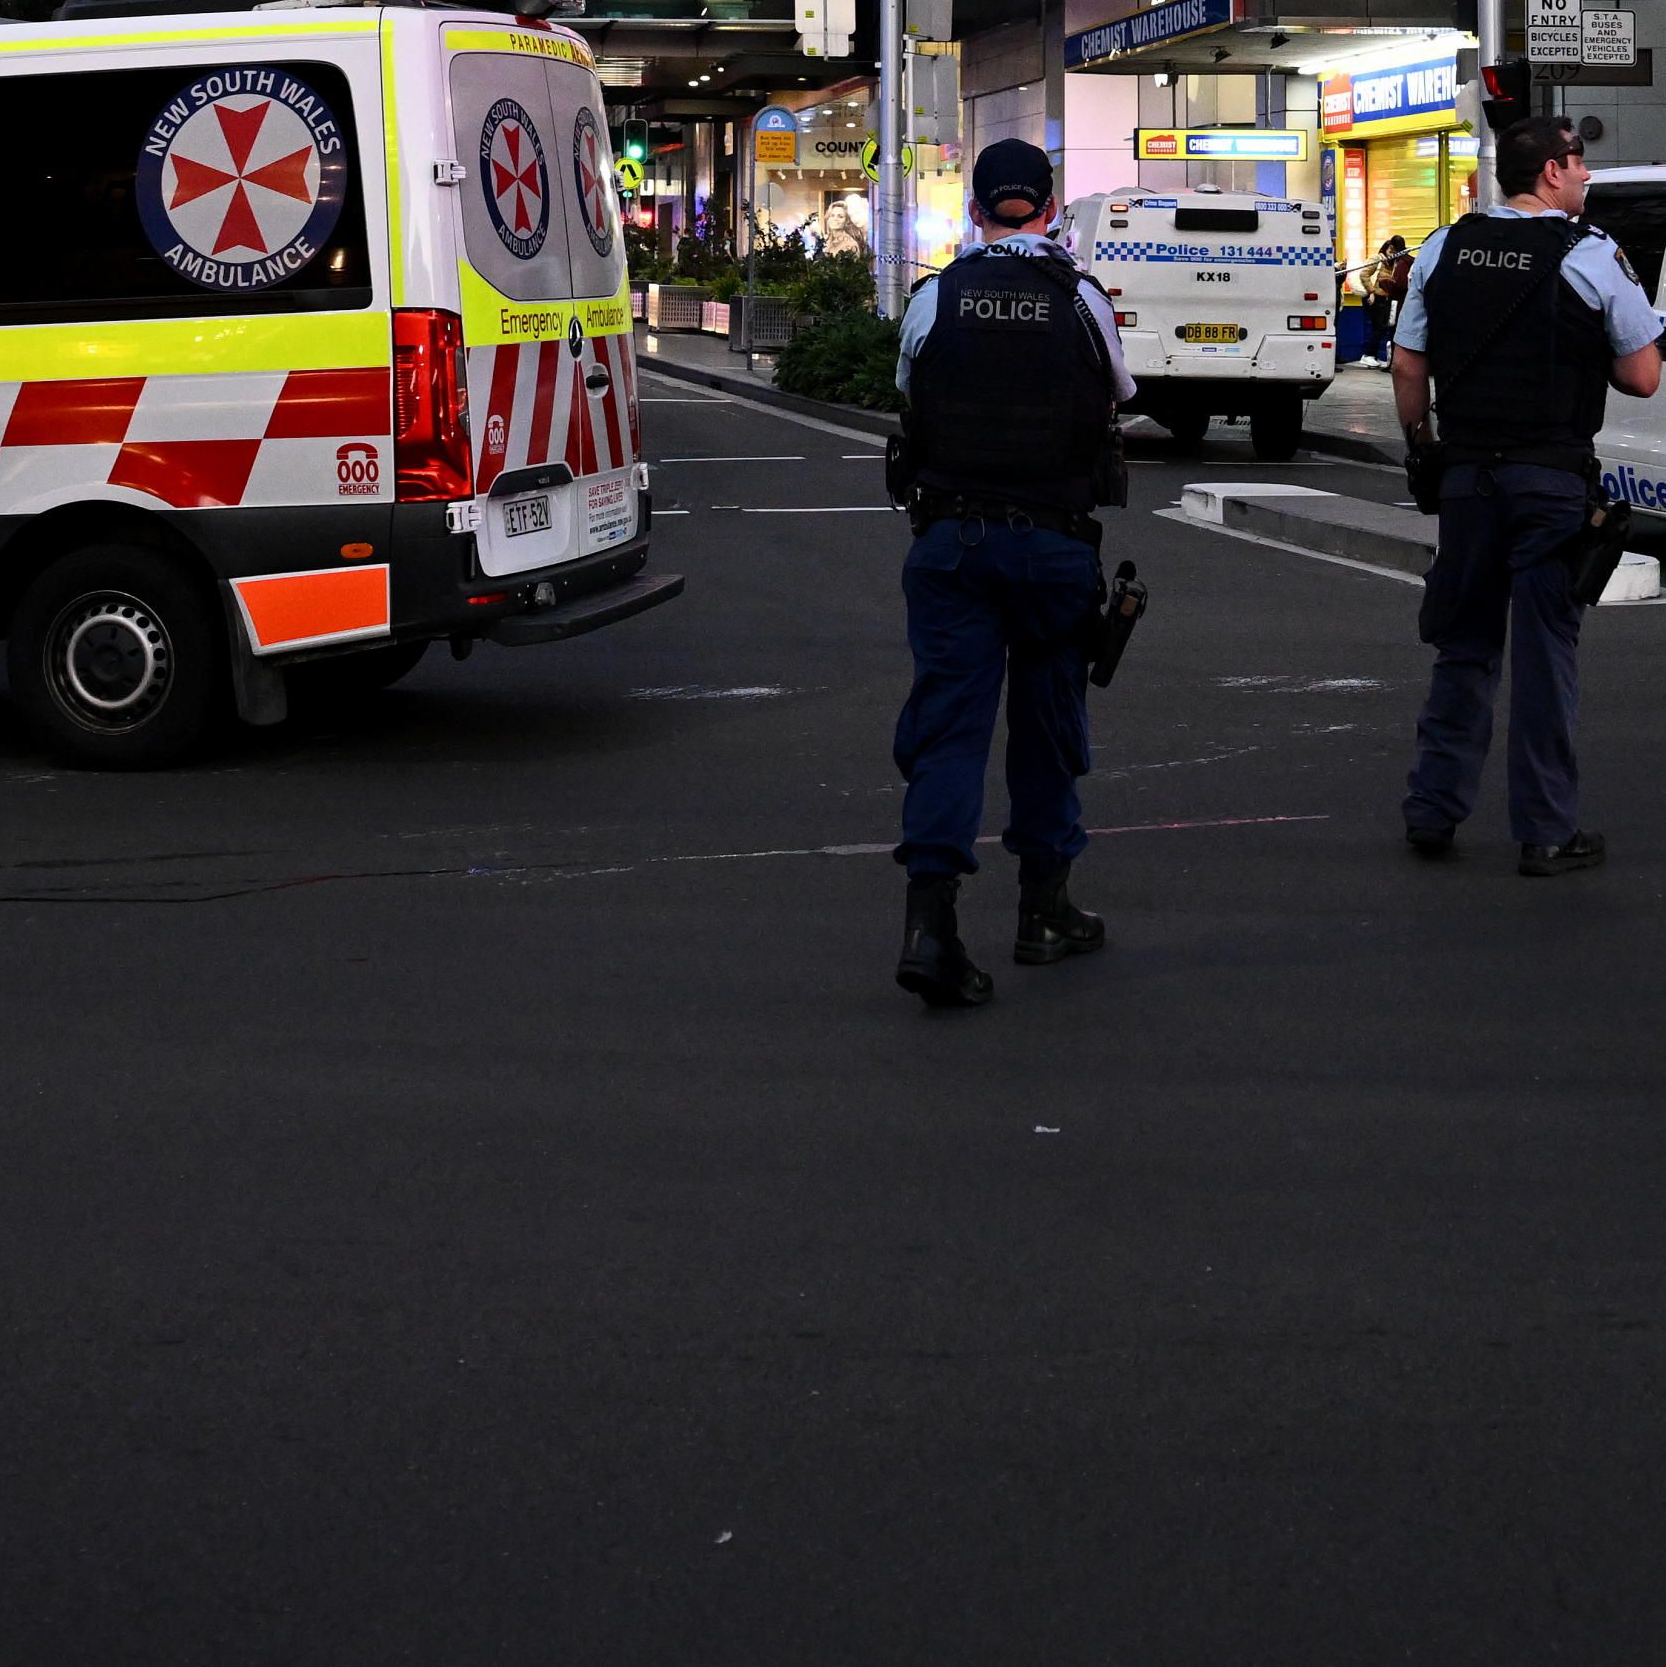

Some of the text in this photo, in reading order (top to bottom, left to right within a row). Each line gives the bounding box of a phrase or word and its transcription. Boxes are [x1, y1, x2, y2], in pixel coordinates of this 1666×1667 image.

[509, 33, 568, 59] PARAMEDIC
[1081, 22, 1127, 59] CHEMIST
[1531, 33, 1578, 42] BICYCLES
[1530, 47, 1579, 56] EXCEPTED
[1586, 45, 1627, 53] VEHICLES
[1587, 53, 1630, 61] EXCEPTED
[1353, 63, 1461, 114] CHEMIST WAREHO
[145, 70, 341, 157] NEW SOUTH WALES
[480, 119, 494, 160] NEW
[491, 100, 519, 121] SOUTH
[520, 109, 545, 167] WALES
[498, 224, 547, 256] AMBULANCE
[1156, 243, 1272, 257] Police 131 444
[164, 236, 316, 287] AMBULANCE
[1456, 248, 1533, 271] POLICE
[1196, 272, 1231, 282] KX18
[960, 289, 1050, 302] NEW SOUTH WALES
[959, 298, 1050, 322] POLICE
[500, 305, 624, 339] Emergency Ambulance
[488, 428, 504, 445] 000
[337, 460, 379, 482] 000
[339, 484, 380, 495] EMERGENCY
